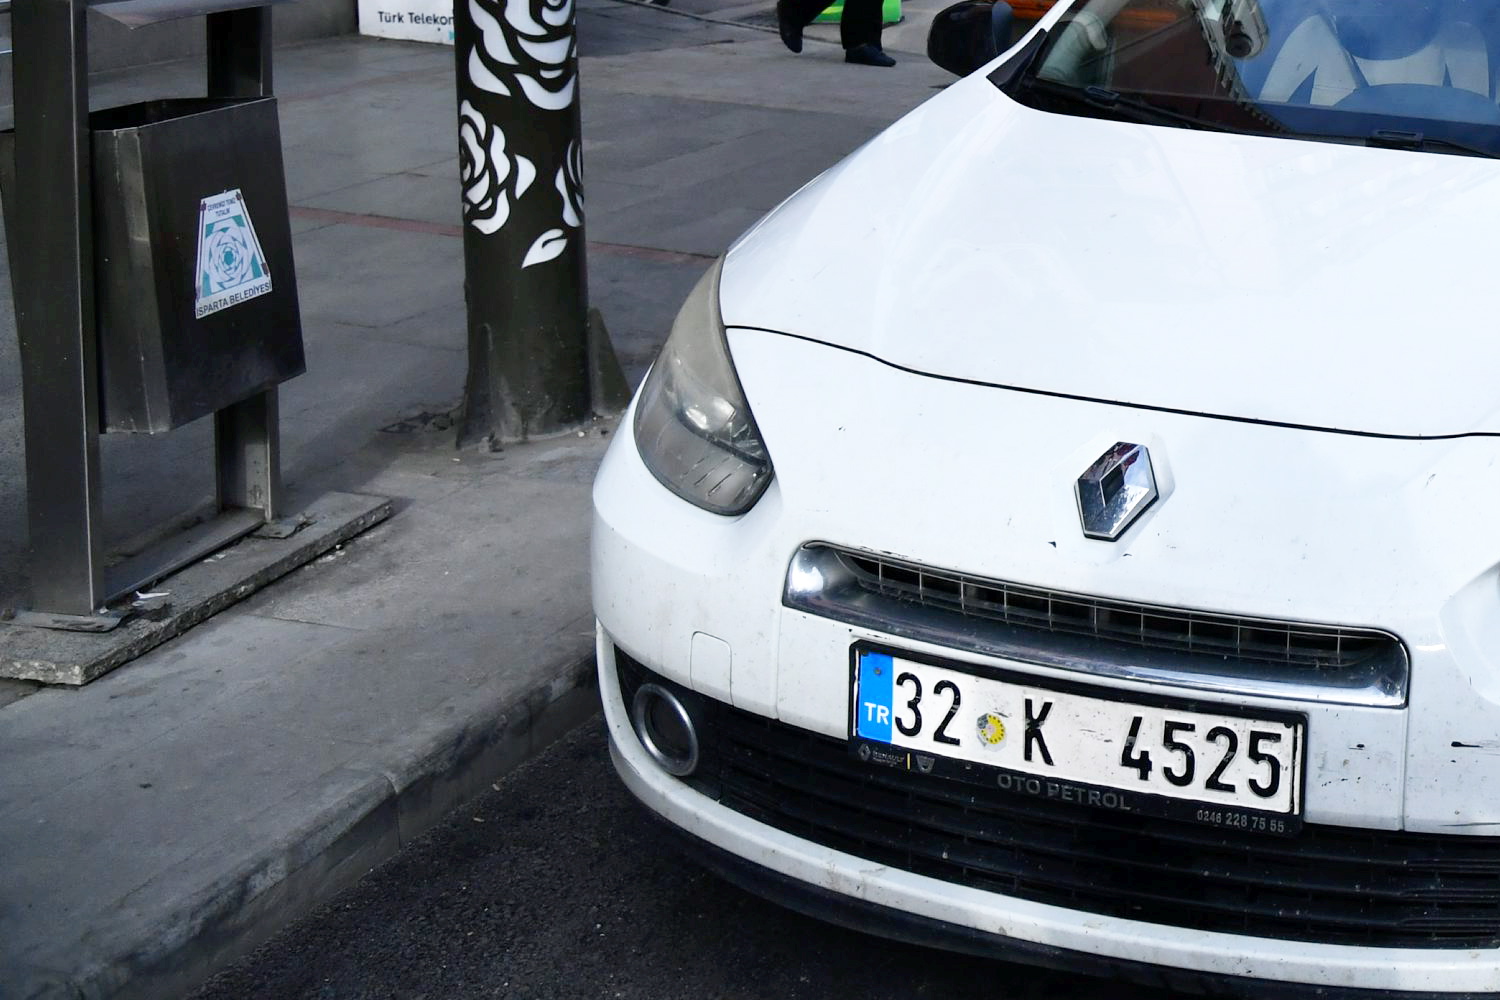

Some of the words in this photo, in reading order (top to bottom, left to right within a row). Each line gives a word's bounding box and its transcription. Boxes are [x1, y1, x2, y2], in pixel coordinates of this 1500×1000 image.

[378, 11, 405, 24] Türk
[229, 280, 272, 305] BELEDİYESİ
[864, 702, 890, 726] TR
[895, 672, 961, 746] 32
[1024, 698, 1055, 766] K
[1121, 716, 1282, 798] 4525
[997, 773, 1041, 794] OTO
[1047, 782, 1133, 811] PETROL
[1197, 810, 1223, 825] 0246
[1226, 812, 1248, 828] 228
[1252, 816, 1267, 831] 75
[1270, 819, 1285, 834] 55
